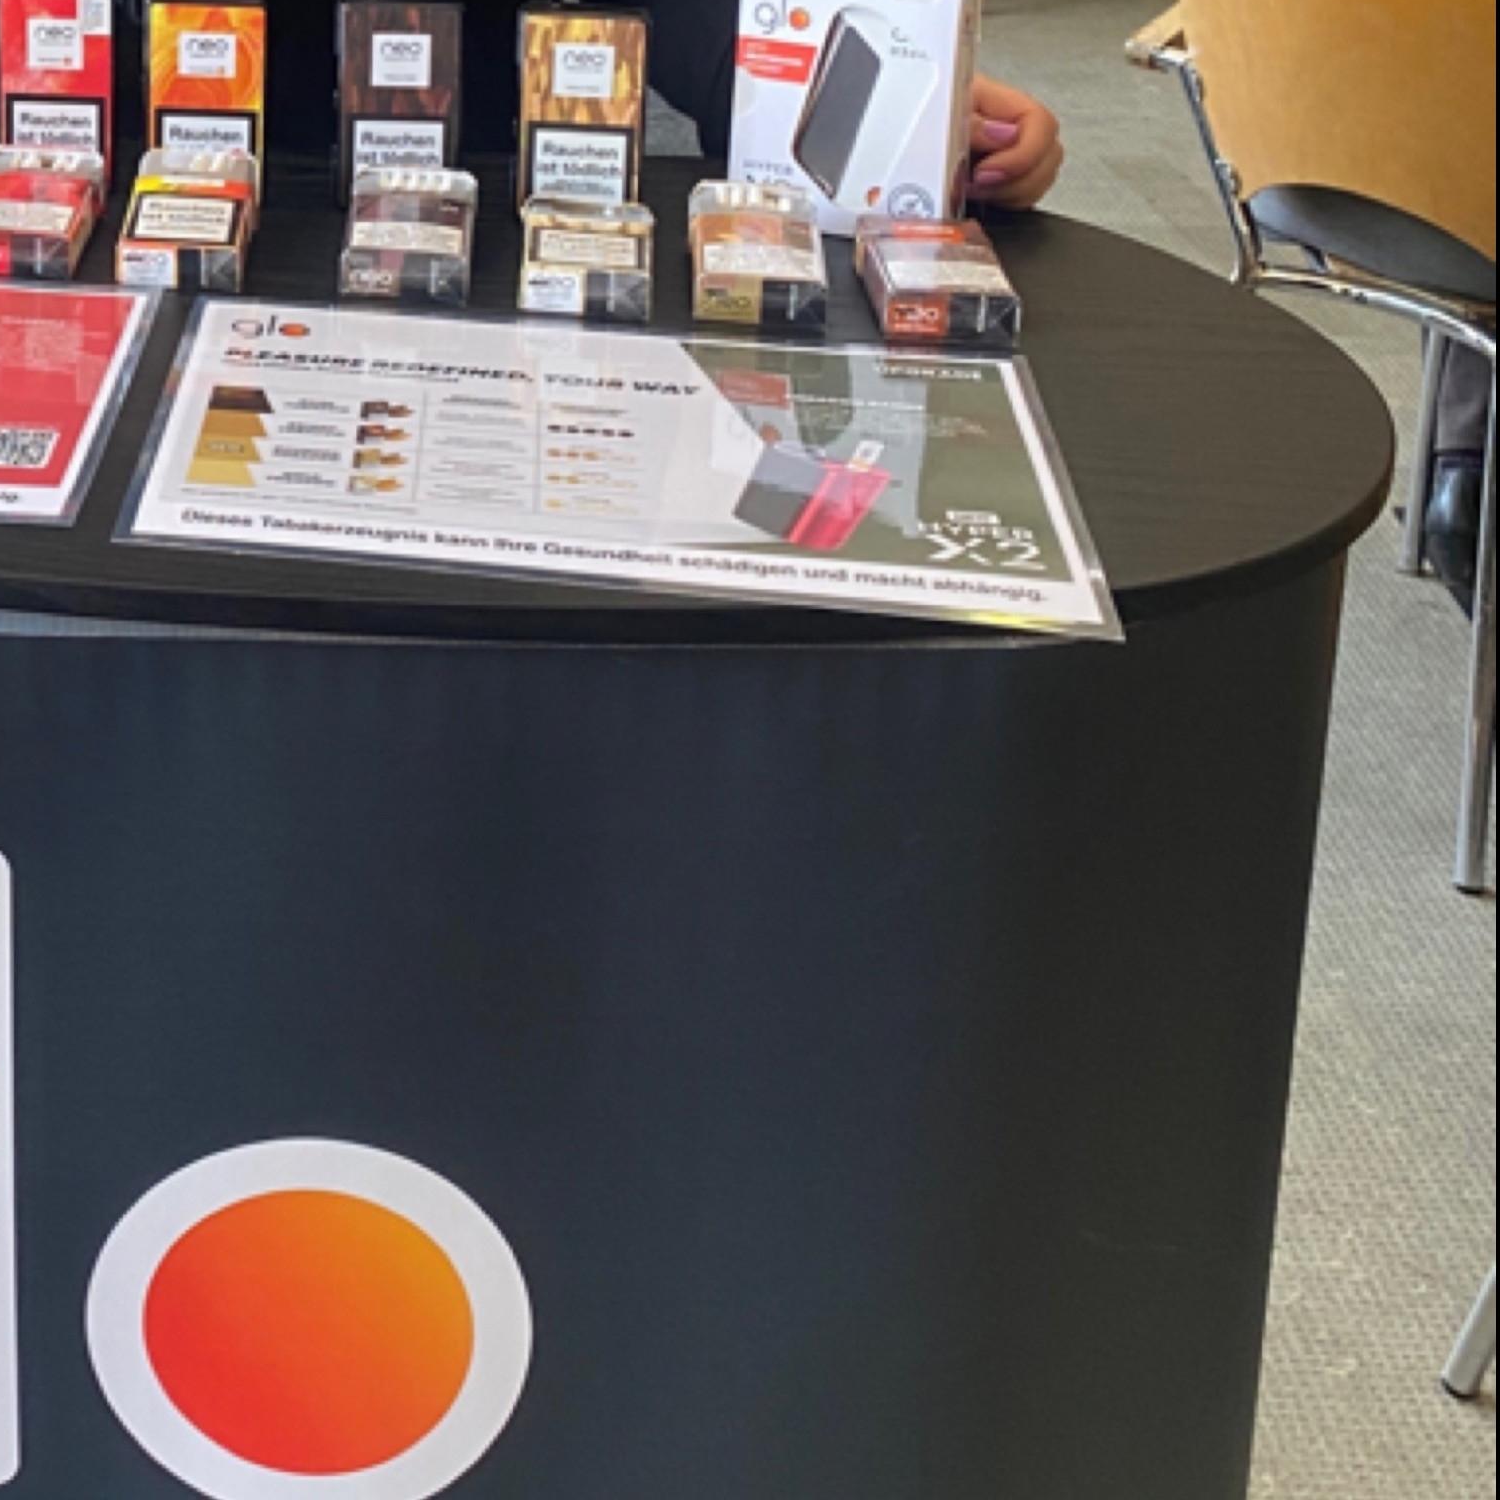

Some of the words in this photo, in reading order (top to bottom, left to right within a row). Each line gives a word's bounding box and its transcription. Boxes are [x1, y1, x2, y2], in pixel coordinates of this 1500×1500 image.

[20, 112, 93, 129] Rauchen
[169, 124, 245, 142] Rauchen
[360, 131, 437, 147] Rauchen
[542, 139, 620, 160] Rauchen
[231, 315, 311, 339] glo
[224, 346, 366, 368] PLEASURE
[543, 373, 625, 390] YOUR
[633, 379, 701, 395] WAY
[181, 506, 253, 528] Dieses
[260, 514, 428, 543] Tabakerzeugnis
[434, 530, 490, 548] kann
[493, 536, 538, 554] Ihre
[543, 541, 673, 566] Gesundheit
[679, 556, 799, 579] schädigen
[804, 567, 849, 583] und
[854, 572, 927, 590] macht
